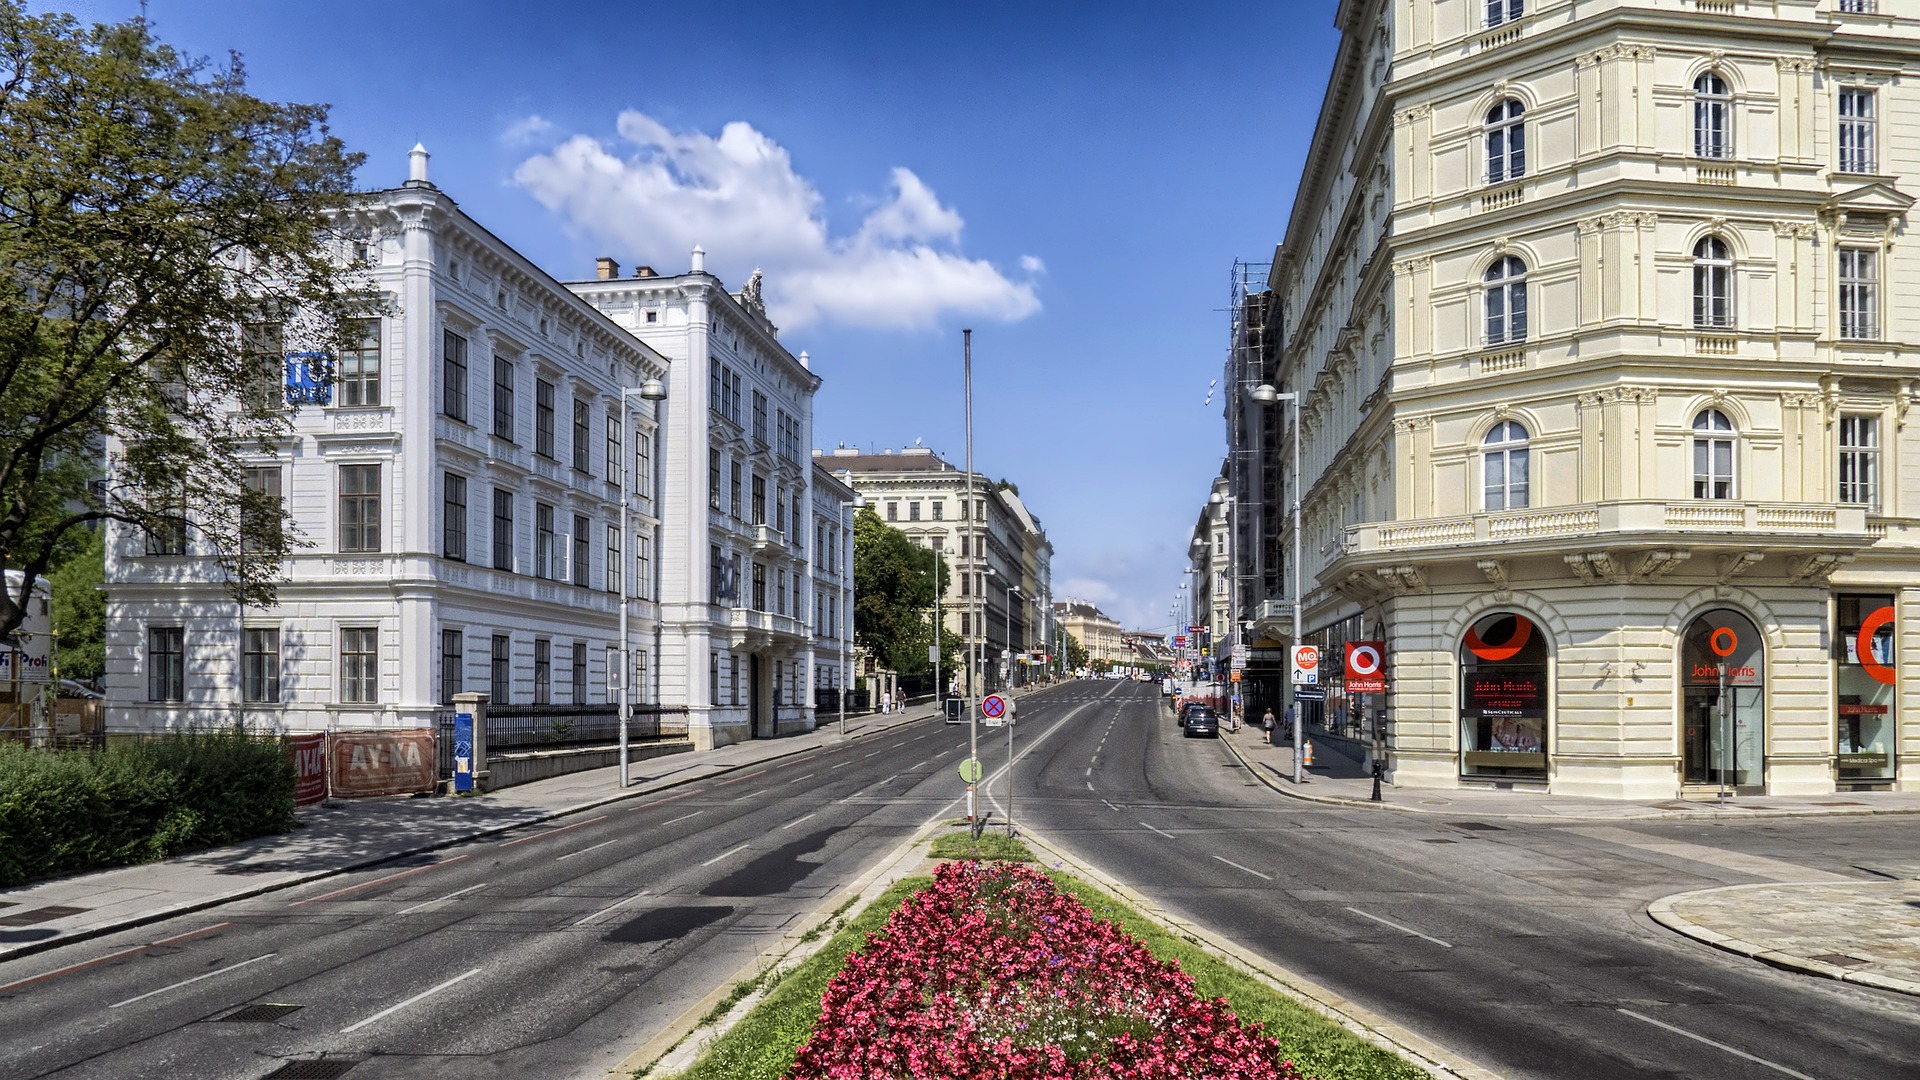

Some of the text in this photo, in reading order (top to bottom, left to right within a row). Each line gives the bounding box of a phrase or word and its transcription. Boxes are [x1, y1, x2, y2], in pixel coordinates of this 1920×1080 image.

[1297, 652, 1318, 662] MQ
[1691, 662, 1718, 677] John
[350, 741, 422, 770] AY-KA
